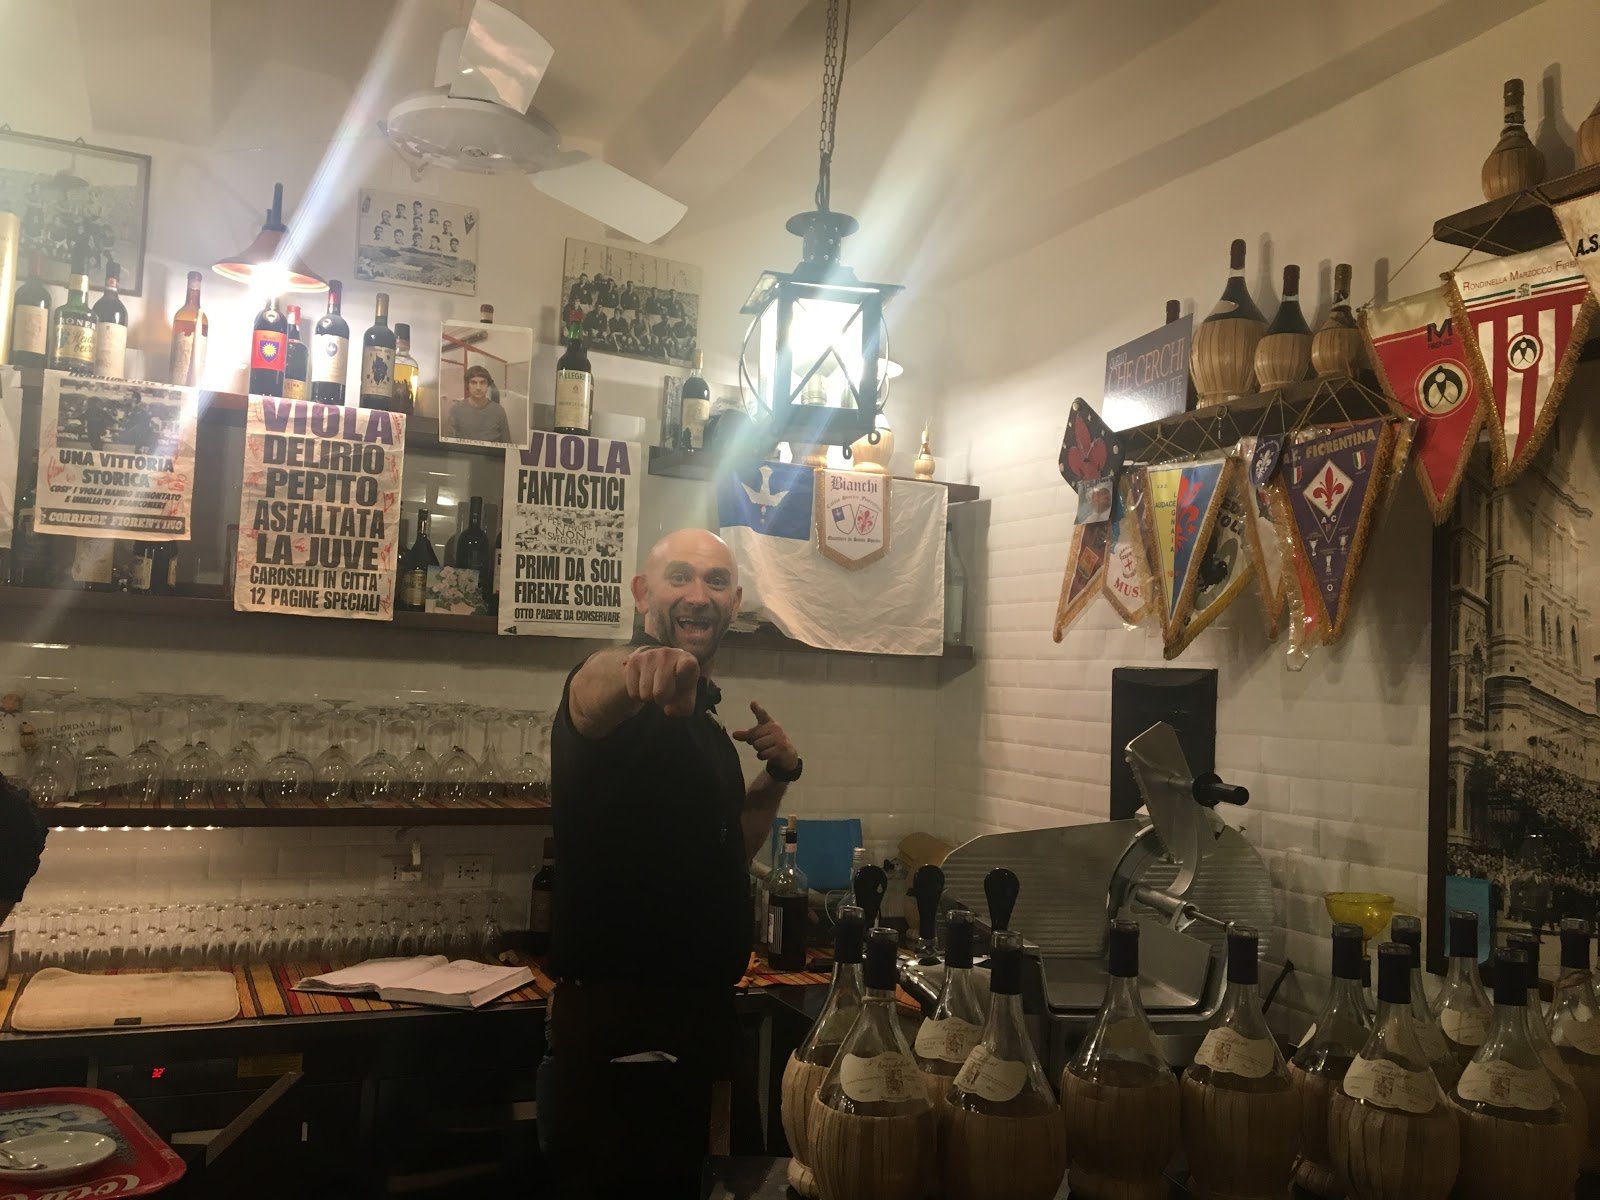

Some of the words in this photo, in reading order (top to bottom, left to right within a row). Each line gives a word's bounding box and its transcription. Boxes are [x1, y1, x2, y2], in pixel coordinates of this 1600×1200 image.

[1427, 317, 1453, 342] M
[1135, 336, 1186, 387] CERCHI
[262, 396, 394, 445] VIOLA
[263, 434, 385, 475] DELIRIO
[520, 432, 631, 475] VIOLA
[1305, 428, 1377, 458] FIORENTINA
[59, 449, 94, 466] UNA
[100, 453, 174, 473] VITTORIA
[79, 486, 102, 496] VIOLA
[82, 469, 150, 488] STORICA
[265, 467, 378, 506] PEPITO
[517, 469, 625, 511] FANTASTICI
[830, 475, 878, 494] Bianchi
[48, 512, 107, 526] CORRIERE
[110, 515, 182, 531] FIORENTINO
[252, 500, 385, 539] ASFALTATA
[256, 533, 293, 565] LA
[305, 536, 379, 571] JUVE
[250, 565, 319, 588] CAROSELLI
[323, 570, 336, 589] IN
[341, 571, 382, 592] CITTA'
[515, 554, 560, 581] PRIMI
[565, 557, 585, 582] DA
[590, 558, 622, 584] SOLI
[250, 587, 266, 605] 12
[270, 588, 319, 609] PAGINE
[323, 590, 380, 612] SPECIALI
[515, 581, 569, 605] FIRENZE
[573, 584, 621, 608] SOGNA
[514, 608, 534, 620] OTTO
[535, 609, 562, 621] PAGINE
[563, 609, 574, 621] DA
[576, 611, 620, 623] CONSERVARE
